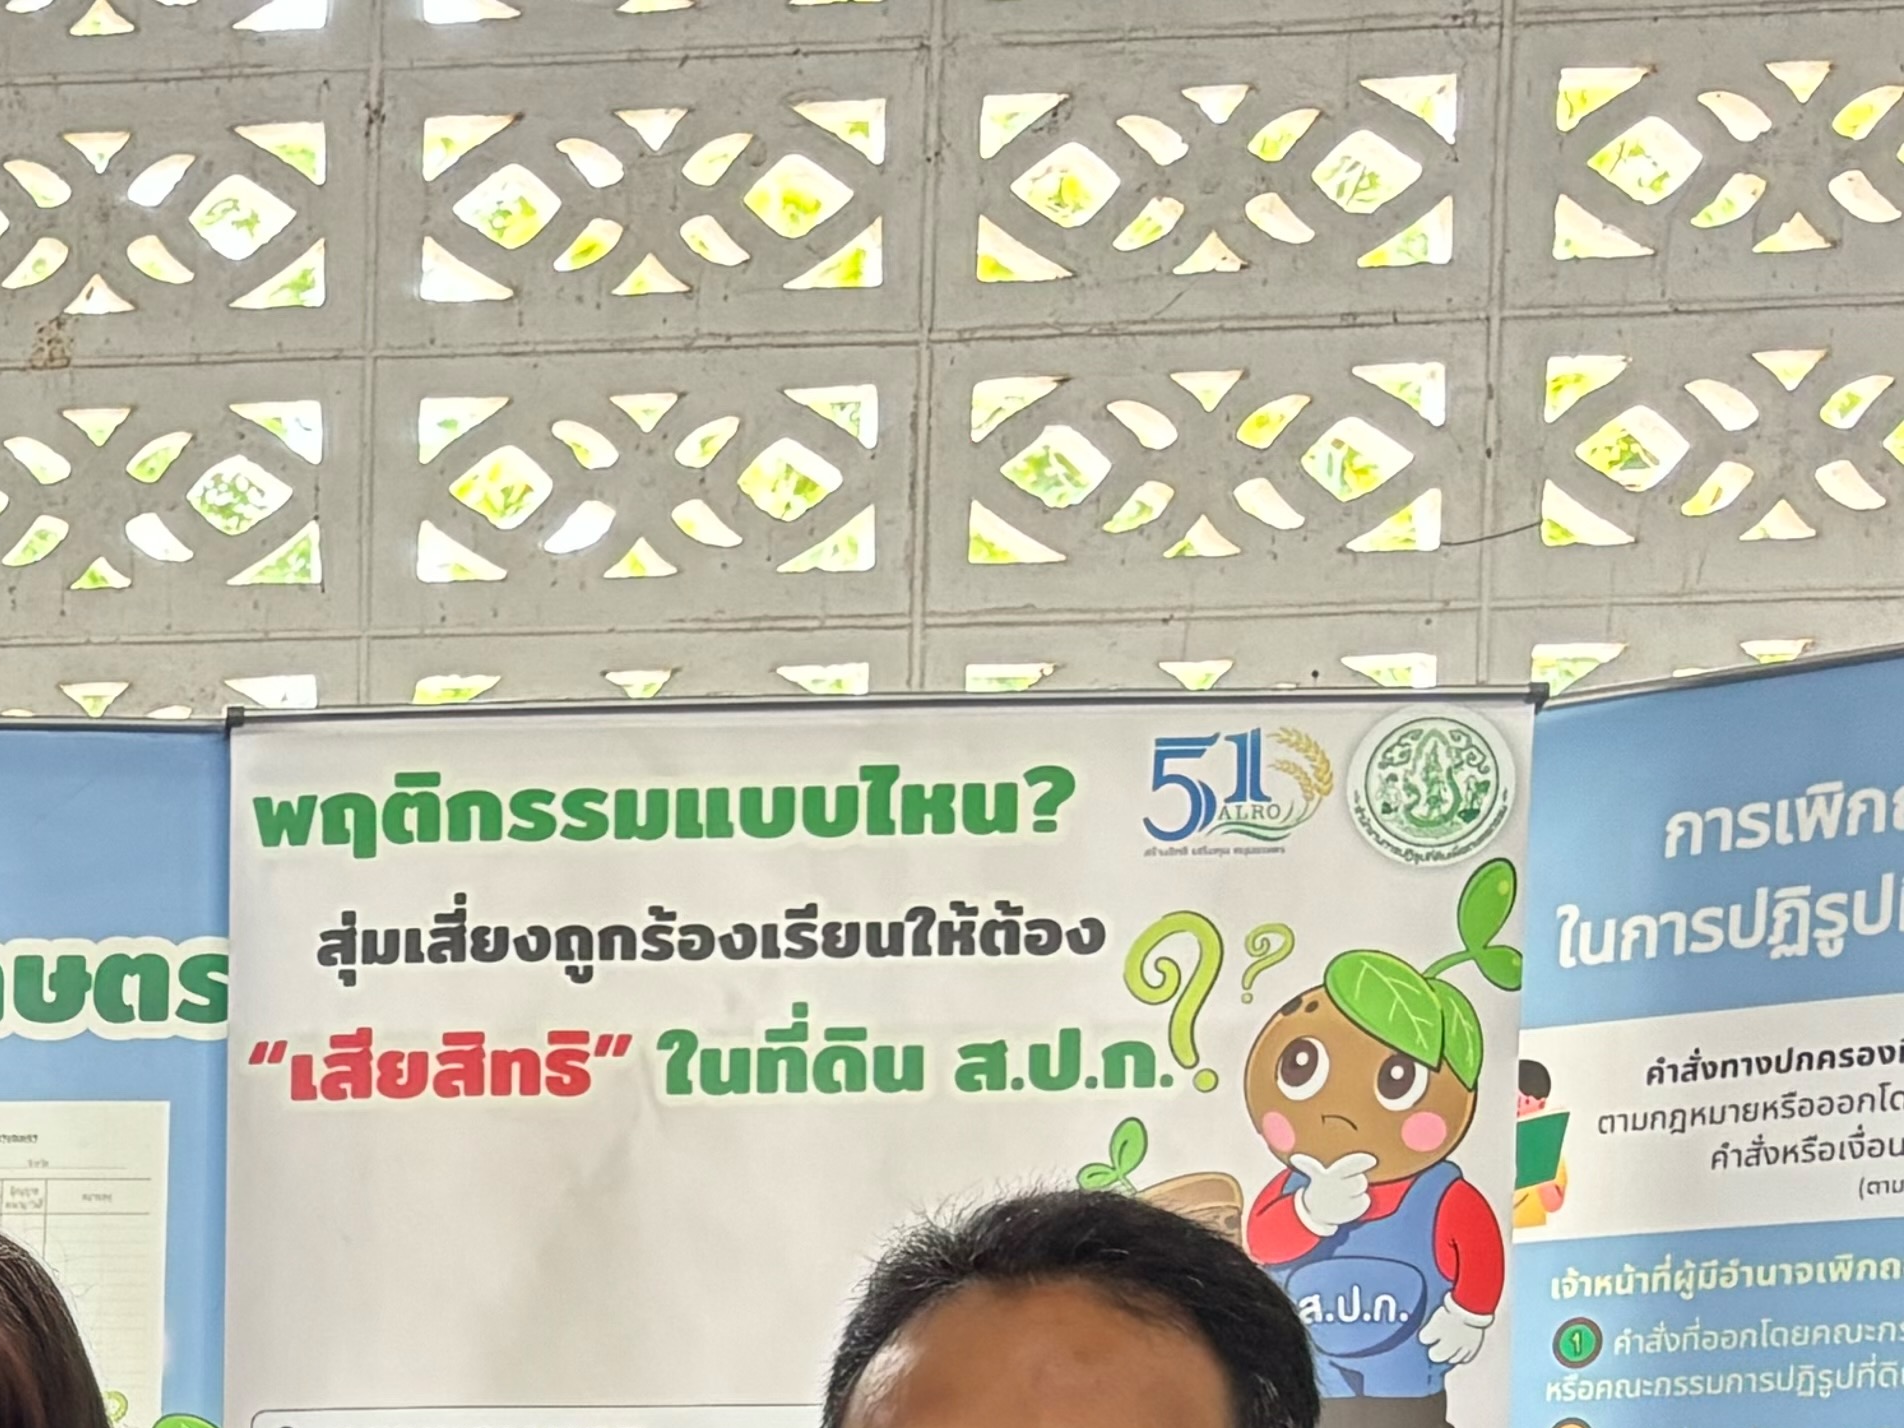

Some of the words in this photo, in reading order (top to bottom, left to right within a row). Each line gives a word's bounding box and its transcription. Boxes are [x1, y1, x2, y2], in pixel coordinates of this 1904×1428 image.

[252, 764, 1077, 860] พฤติกรรมแบบไหน?
[1142, 726, 1273, 842] 51
[1218, 803, 1282, 821] ALRO
[315, 892, 1107, 988] สุ่มเสี่ยงถูกร้องเรียนให้ต้อง
[1555, 872, 1904, 970] ในการปฏิรูป
[657, 1002, 924, 1097] ในที่ดิน
[955, 1026, 1175, 1093] ส.ป.ก.
[1645, 1038, 1904, 1087] คำสั่งทางปกครอง
[1298, 1284, 1409, 1325] ส.ป.ก.
[1546, 1352, 1904, 1402] หรือคณะกรรมการปฏิรูปที่ดิ
